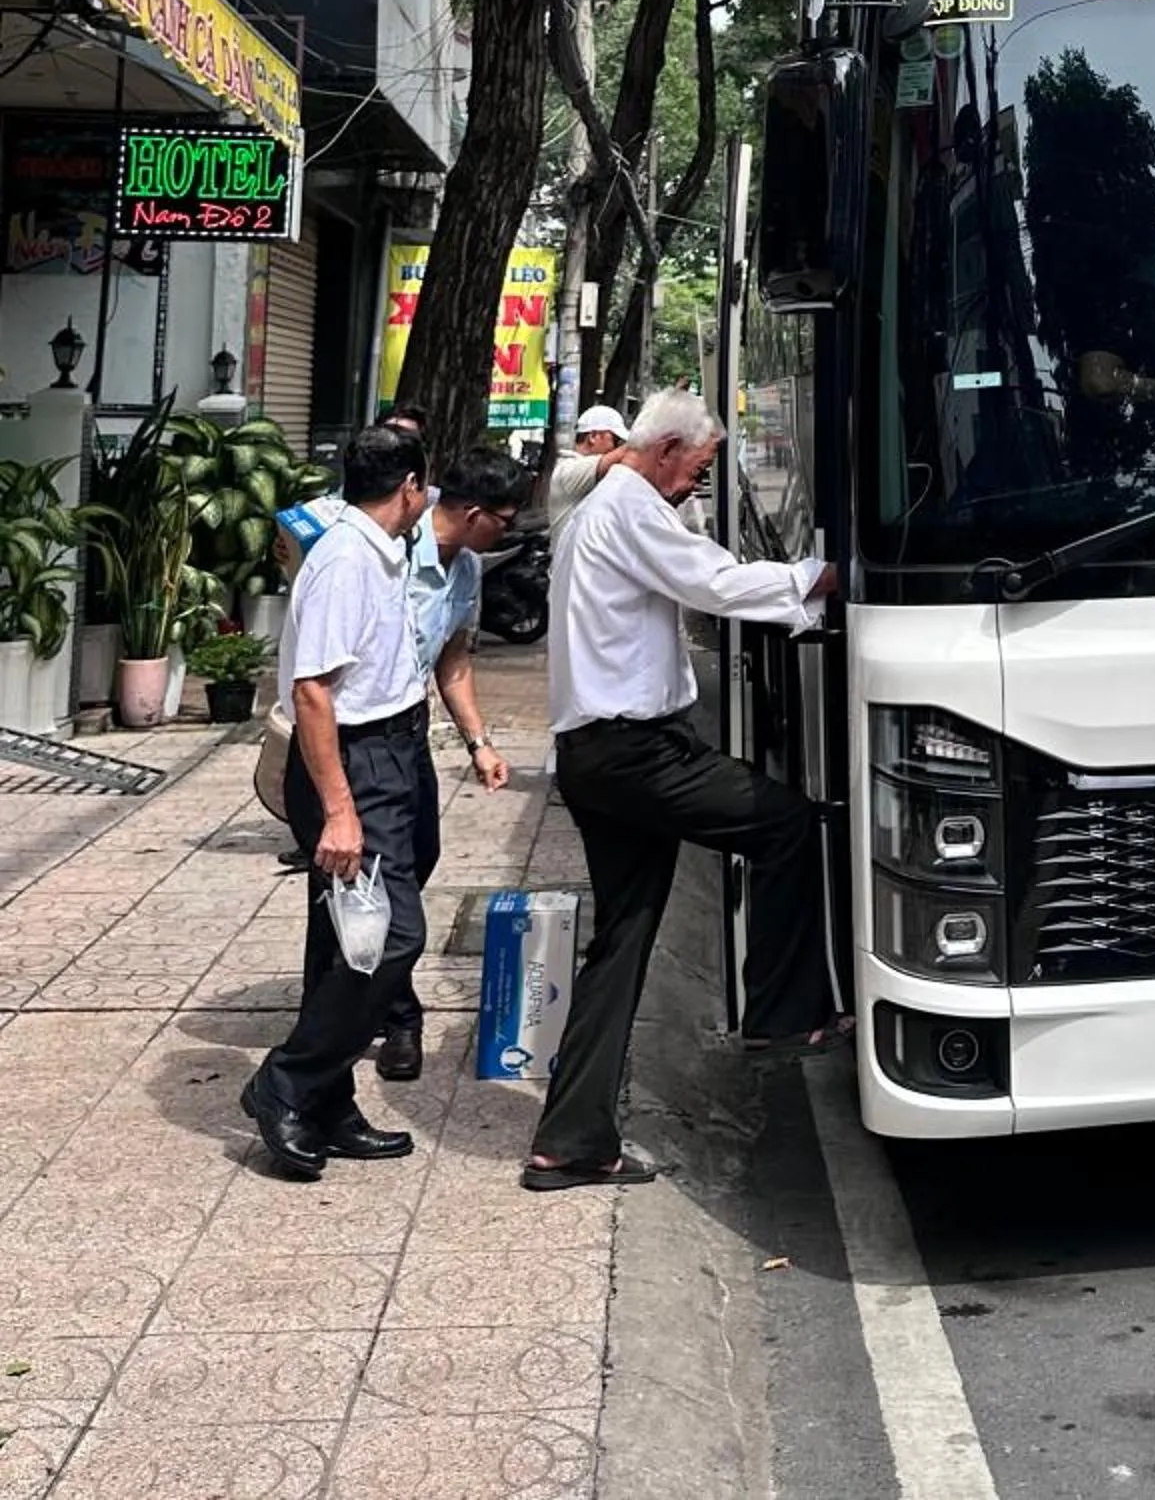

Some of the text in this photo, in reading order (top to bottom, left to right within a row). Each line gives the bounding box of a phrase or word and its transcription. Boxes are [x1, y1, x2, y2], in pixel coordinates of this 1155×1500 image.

[126, 136, 286, 200] HOTEL
[132, 201, 273, 229] Nam Đô 2
